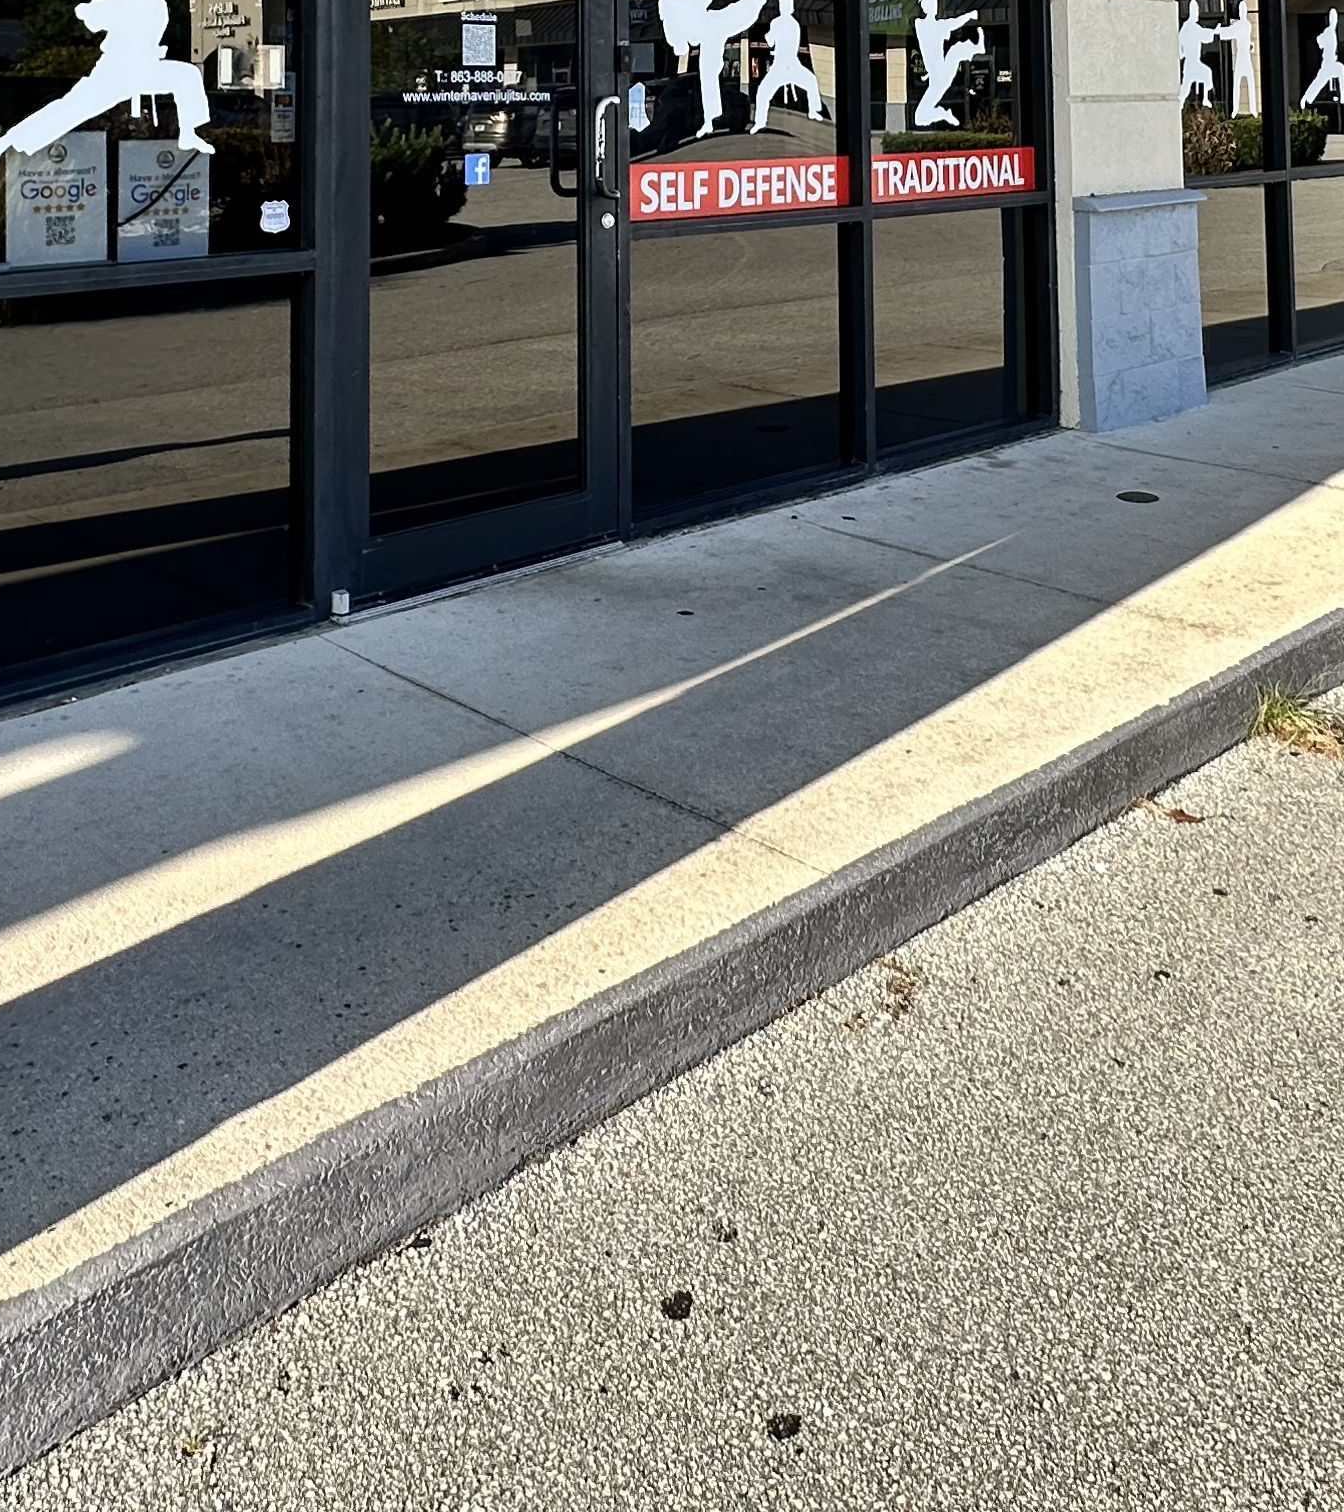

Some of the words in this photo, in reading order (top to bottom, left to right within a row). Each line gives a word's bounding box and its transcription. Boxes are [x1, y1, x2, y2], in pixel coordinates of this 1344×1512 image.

[461, 11, 498, 22] Schedule
[450, 70, 523, 84] 863-888-07
[402, 89, 551, 105] www.winterhavenjiujitsu.com
[872, 153, 1025, 197] TRADITIONAL
[20, 177, 97, 203] Google
[130, 183, 201, 207] Google
[640, 169, 709, 215] SELF
[717, 164, 837, 209] DEFENSE
